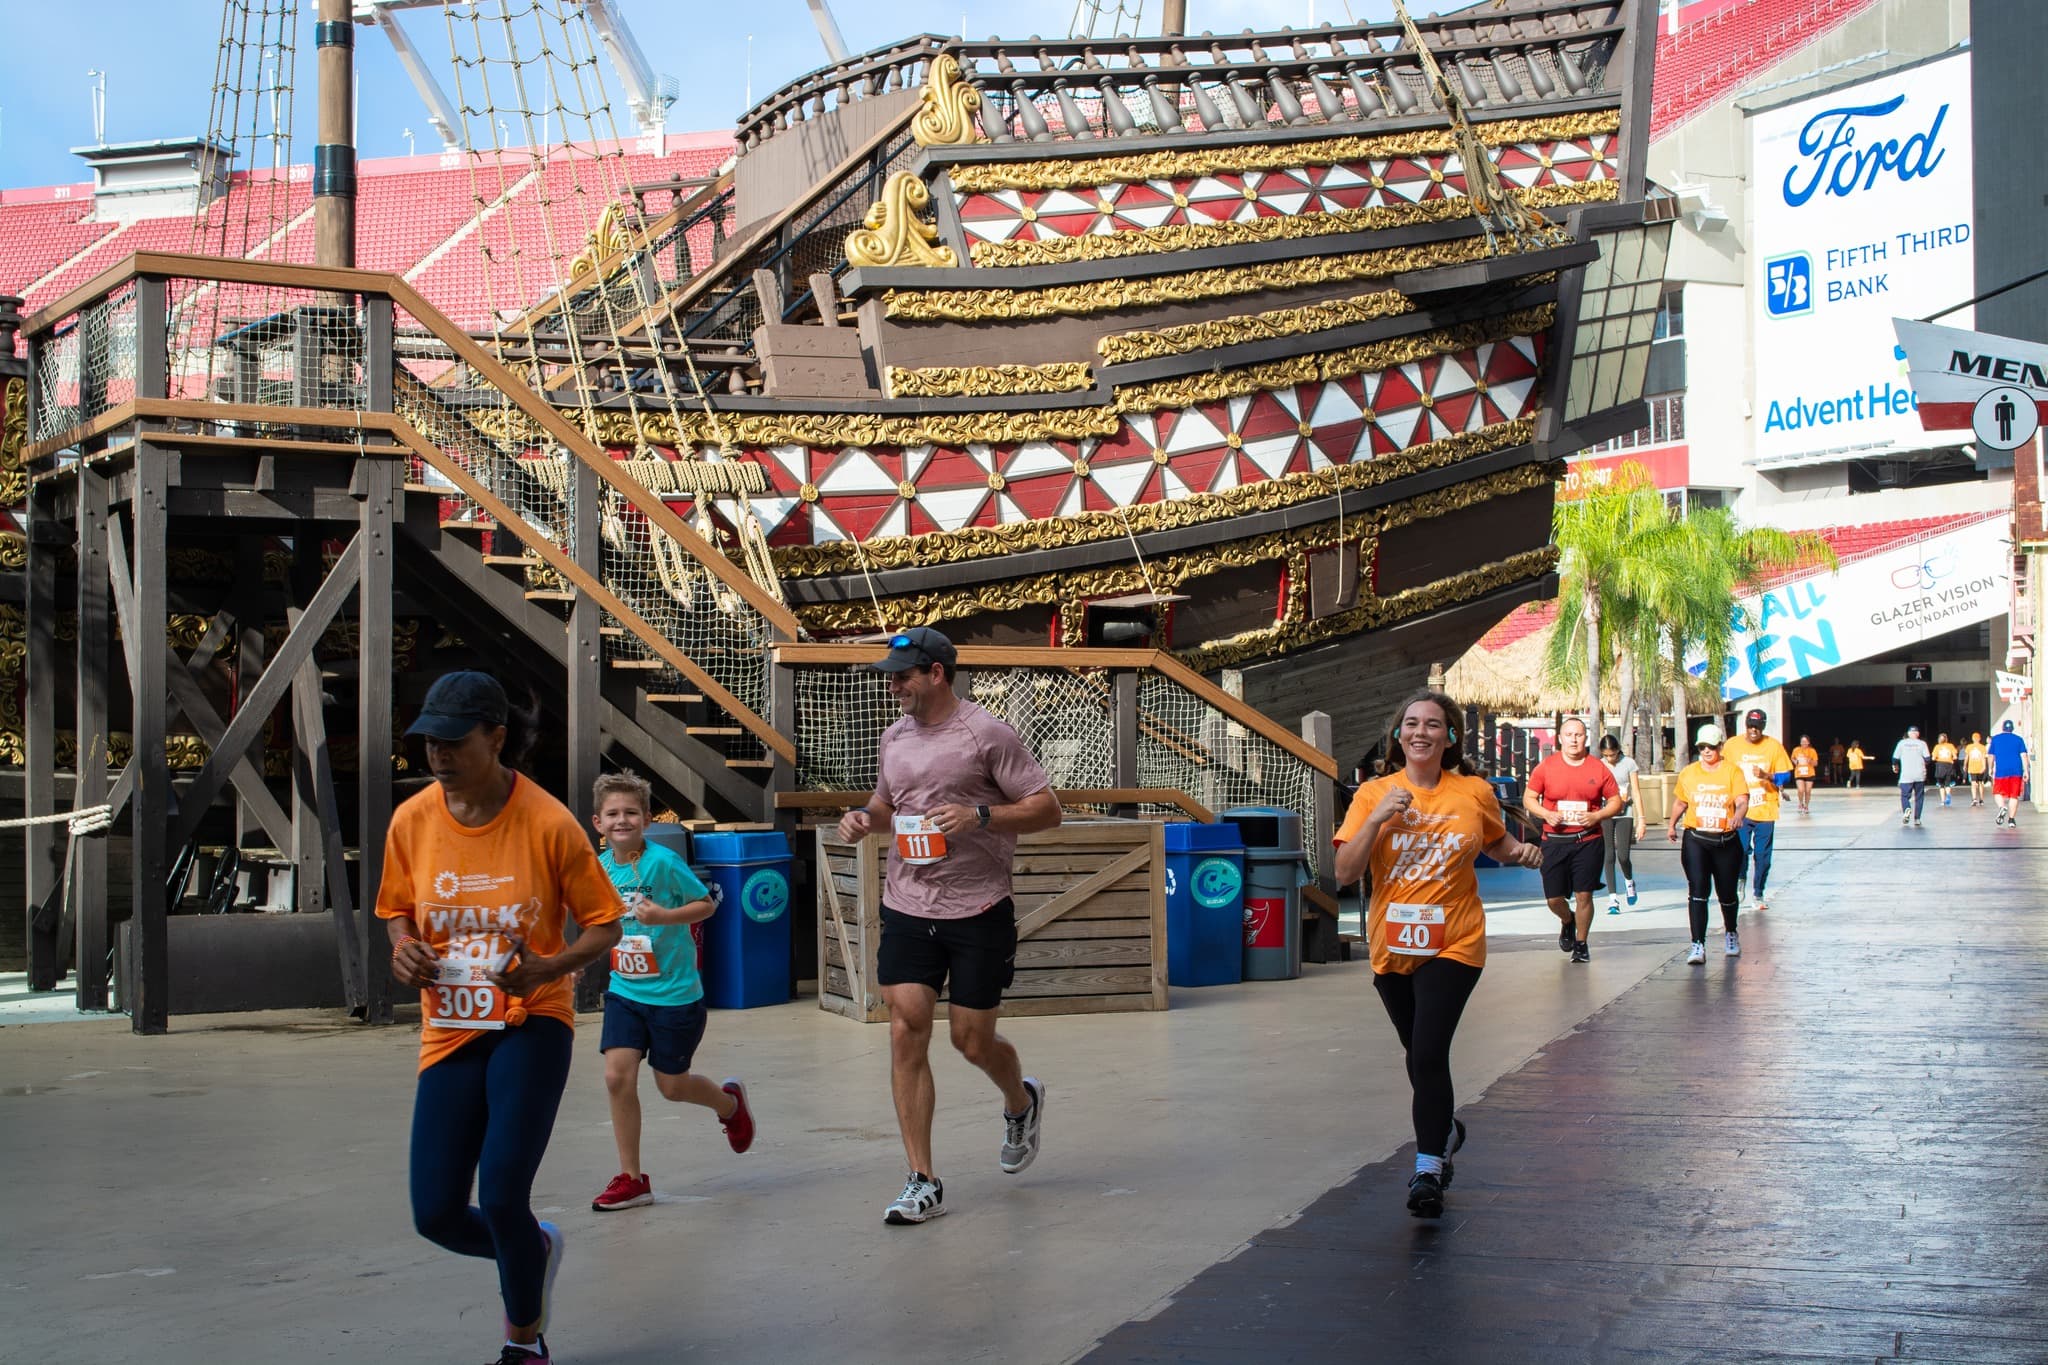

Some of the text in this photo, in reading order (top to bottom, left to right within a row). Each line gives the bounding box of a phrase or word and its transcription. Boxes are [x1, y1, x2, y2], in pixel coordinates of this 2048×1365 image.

[1783, 94, 1949, 208] Ford
[54, 187, 70, 199] 311
[1827, 223, 1970, 271] FIFTH THIRD
[1828, 274, 1889, 302] BANK
[1949, 350, 2048, 389] MEN
[1761, 582, 1827, 631] ALL
[1871, 576, 1994, 626] GLAZER VISION
[1898, 599, 1978, 632] FOUNDATION
[1701, 816, 1720, 828] 191
[906, 835, 930, 857] 111
[1391, 831, 1466, 850] WALK
[1397, 850, 1452, 865] RUN
[1389, 863, 1448, 881] ROLL
[429, 904, 522, 932] WALK
[1398, 924, 1430, 948] 40
[617, 951, 649, 973] 108
[437, 987, 494, 1019] 309
